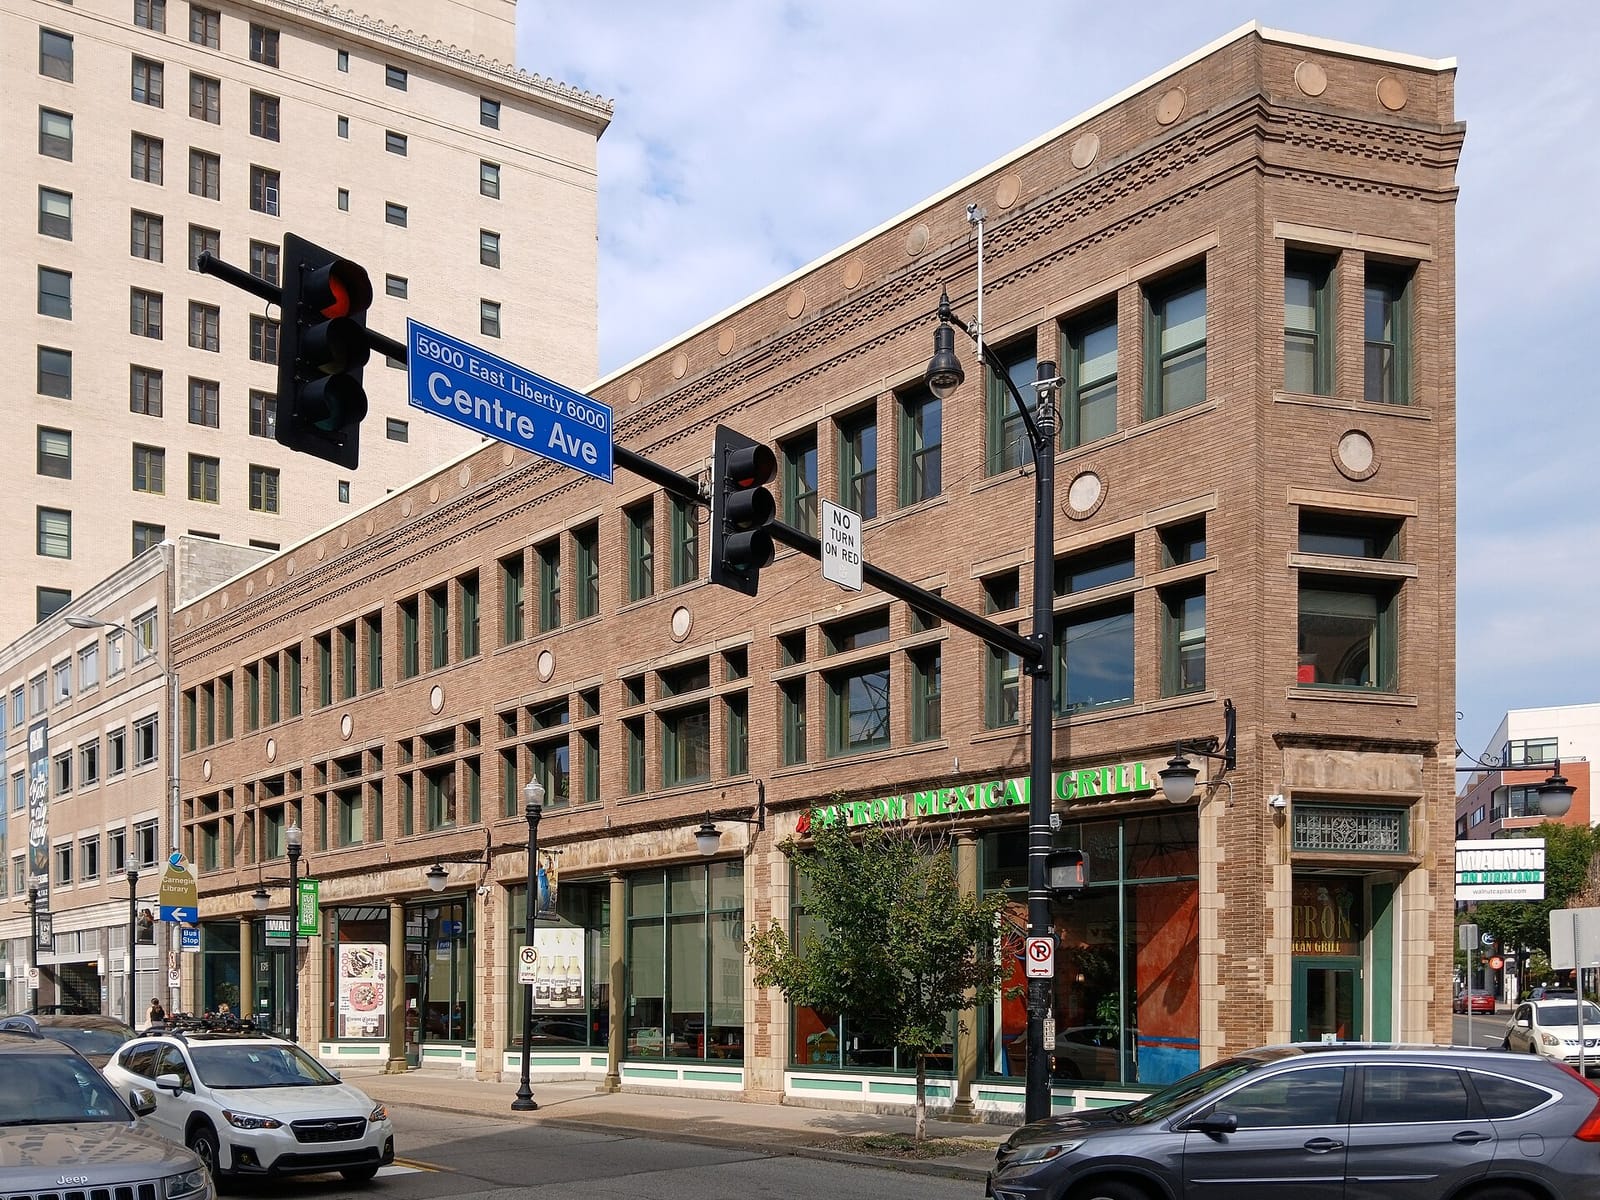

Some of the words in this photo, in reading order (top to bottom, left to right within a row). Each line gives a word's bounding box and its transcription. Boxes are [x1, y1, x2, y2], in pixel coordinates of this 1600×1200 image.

[418, 337, 464, 369] 5900
[469, 358, 505, 387] East
[511, 377, 563, 414] Liberty
[567, 401, 605, 429] 6000
[428, 371, 534, 440] Centre
[548, 422, 598, 465] Ave
[833, 510, 851, 530] NO
[830, 527, 854, 548] TURN
[825, 542, 838, 557] ON
[841, 548, 859, 565] RED
[913, 777, 1031, 817] MEXICA
[1055, 762, 1152, 801] GRILL
[1460, 849, 1542, 871] WALNUT
[162, 876, 196, 887] Carnegie
[1461, 871, 1478, 884] ON
[1481, 871, 1541, 883] HIGHLAND
[162, 885, 189, 894] Library
[1472, 887, 1527, 896] walnutcapital.com
[1291, 903, 1352, 940] TRON
[183, 929, 197, 937] Bus
[182, 937, 199, 946] Stop
[1314, 940, 1341, 953] GRILL
[56, 1175, 88, 1185] Jeep
